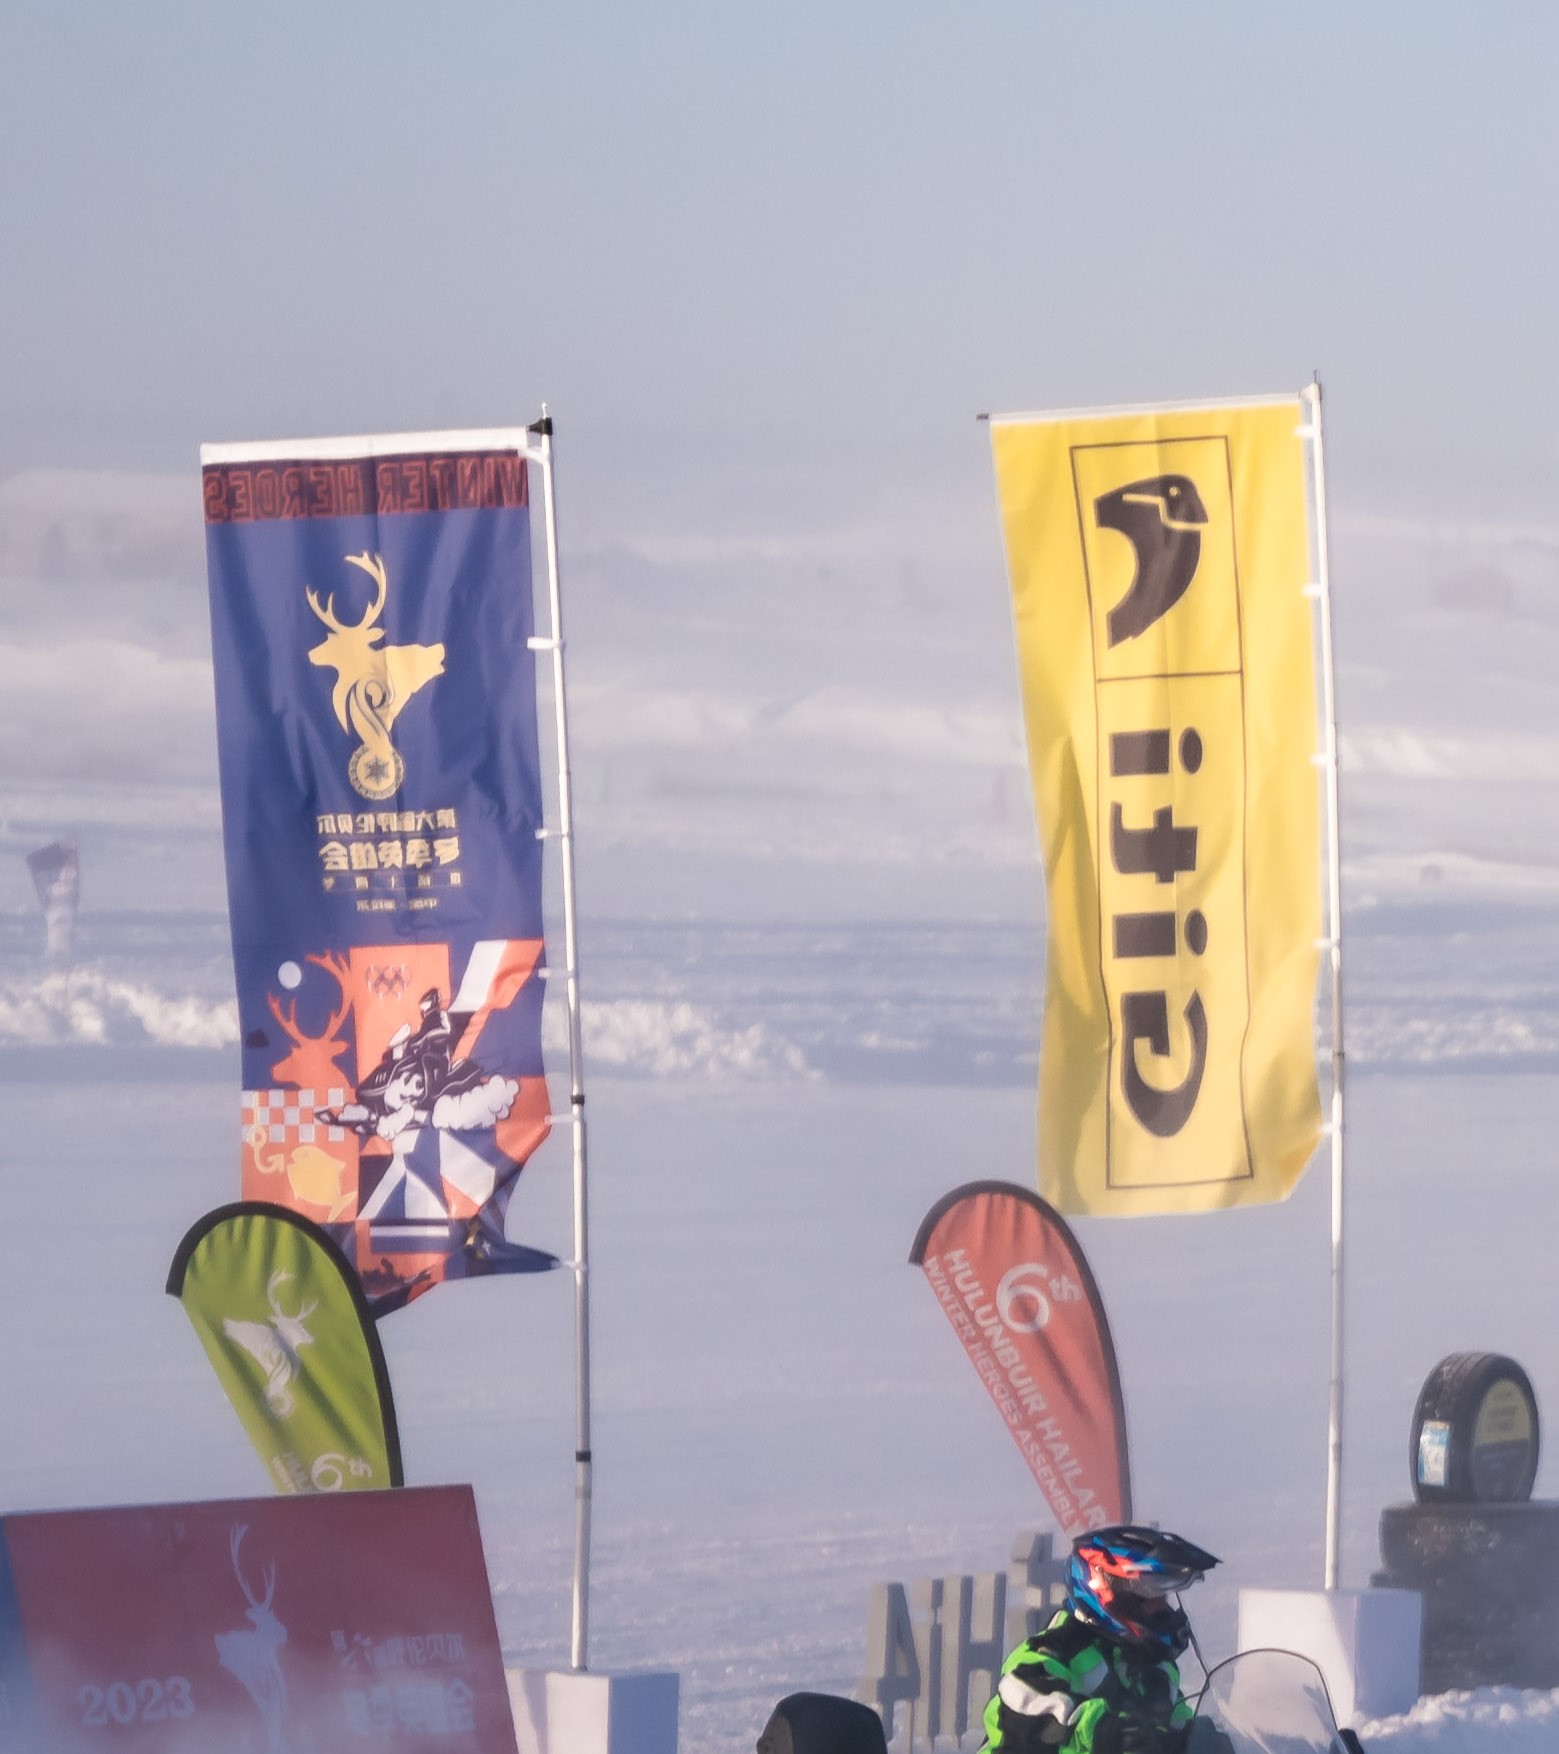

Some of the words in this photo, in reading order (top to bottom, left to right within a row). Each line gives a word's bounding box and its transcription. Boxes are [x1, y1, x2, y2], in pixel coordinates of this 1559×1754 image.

[925, 1254, 976, 1340] WINTER
[967, 1340, 1024, 1426] HEROES
[944, 1247, 1049, 1417] HULUNBUIR
[1036, 1416, 1108, 1530] HAILAR
[76, 1675, 197, 1728] 2023
